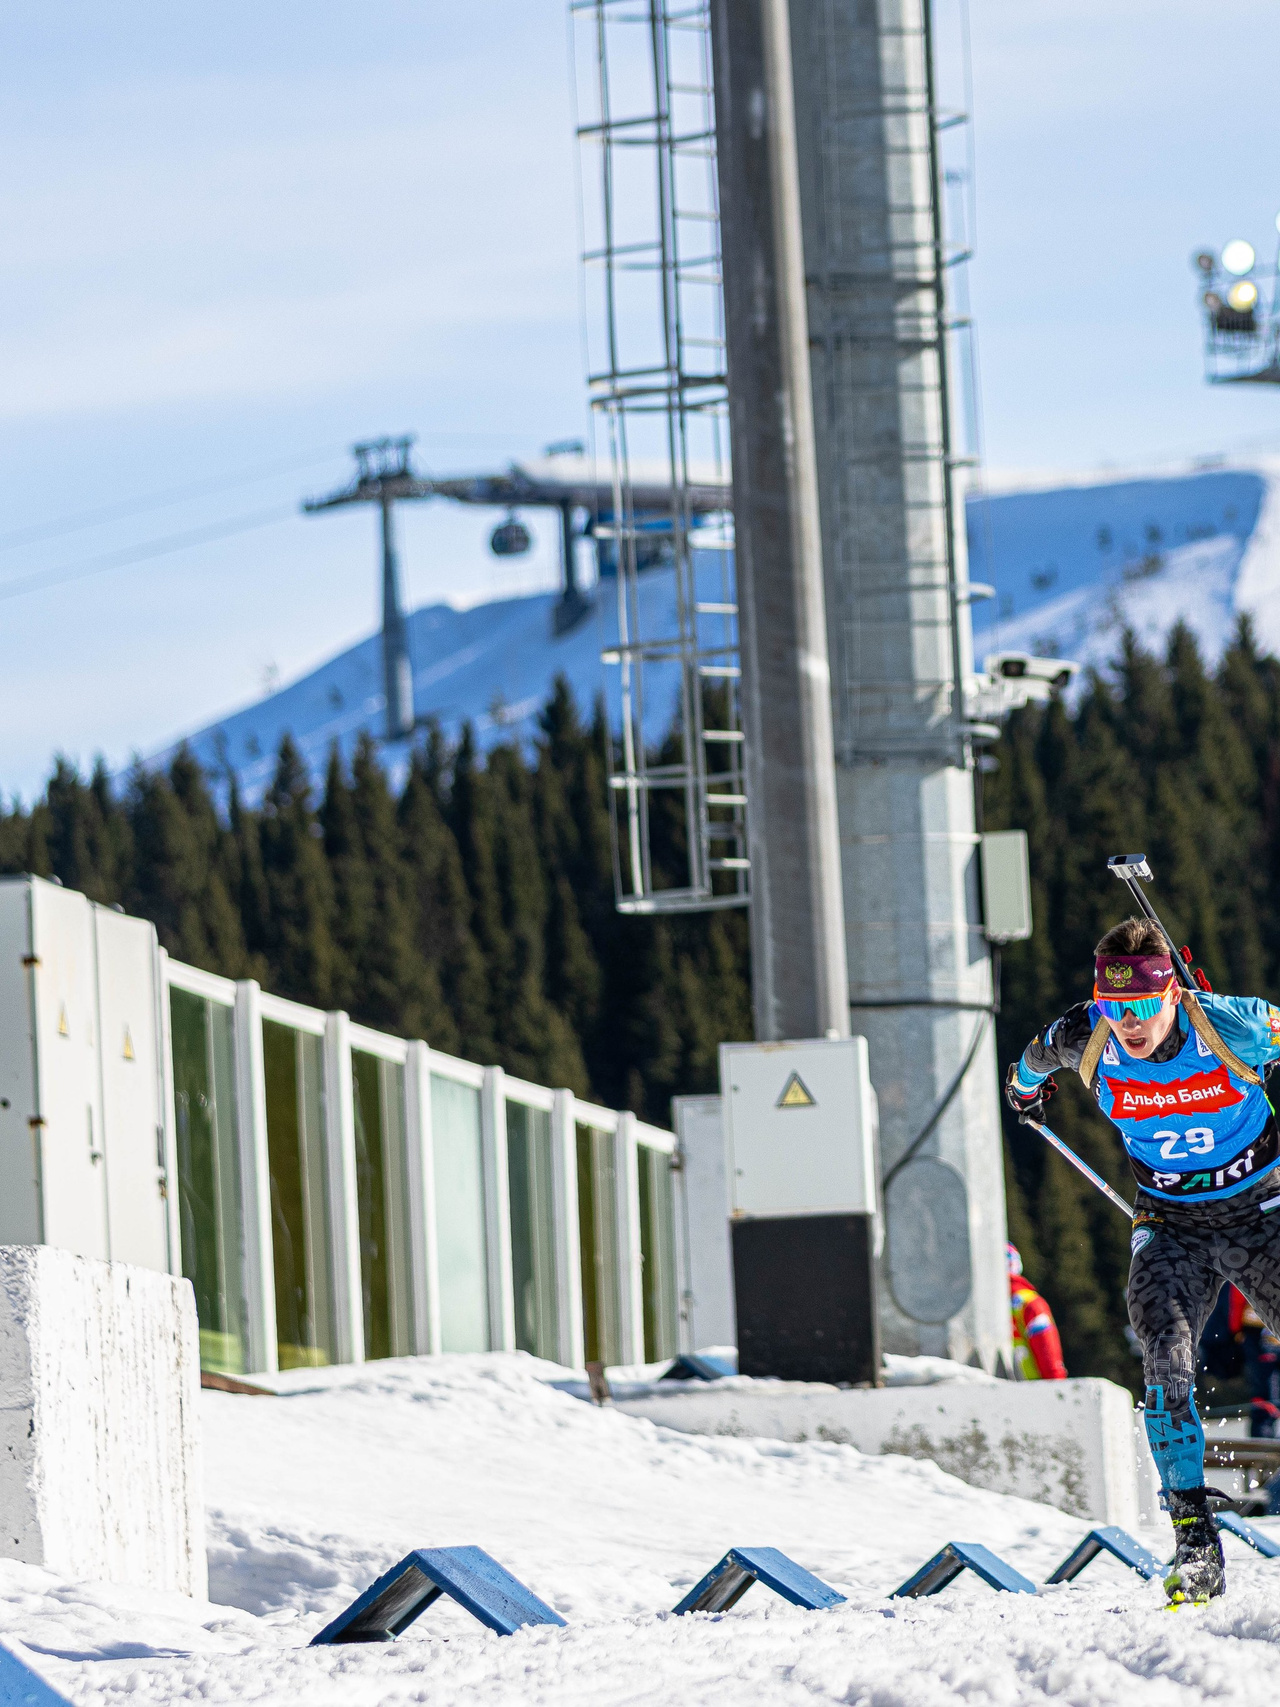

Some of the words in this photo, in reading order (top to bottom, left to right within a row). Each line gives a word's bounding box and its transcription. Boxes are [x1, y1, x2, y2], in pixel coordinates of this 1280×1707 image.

[1122, 1091, 1177, 1109] Альфа
[1178, 1083, 1226, 1103] Банк
[1153, 1127, 1215, 1160] 29
